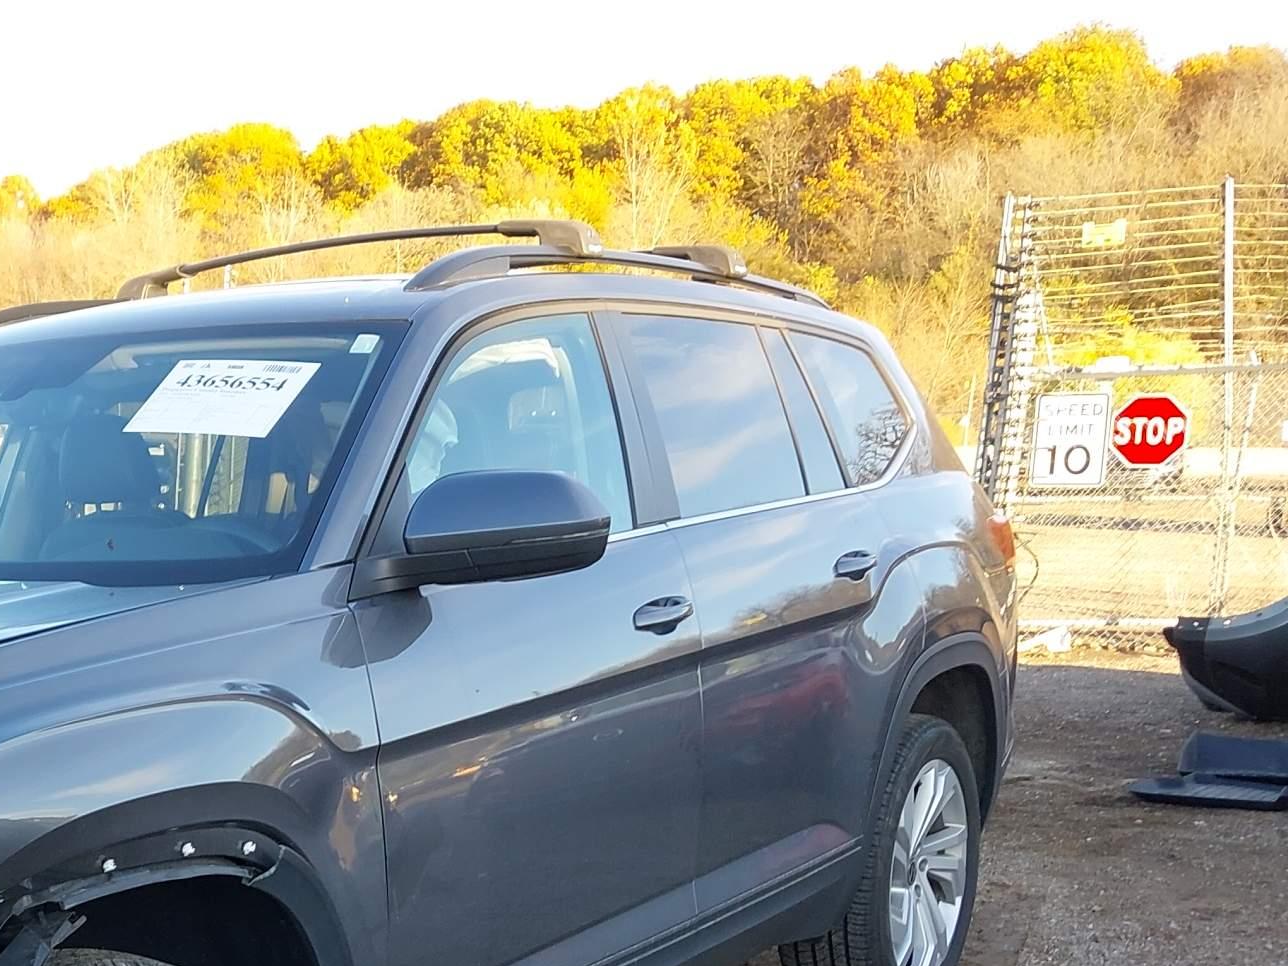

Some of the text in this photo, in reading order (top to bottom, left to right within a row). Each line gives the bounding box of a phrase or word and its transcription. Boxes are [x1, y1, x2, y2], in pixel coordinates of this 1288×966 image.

[176, 374, 289, 392] 43656554
[1045, 403, 1103, 416] SPEED
[1047, 423, 1095, 436] LIMIT
[1114, 416, 1185, 446] STOP
[1047, 444, 1091, 475] 10
